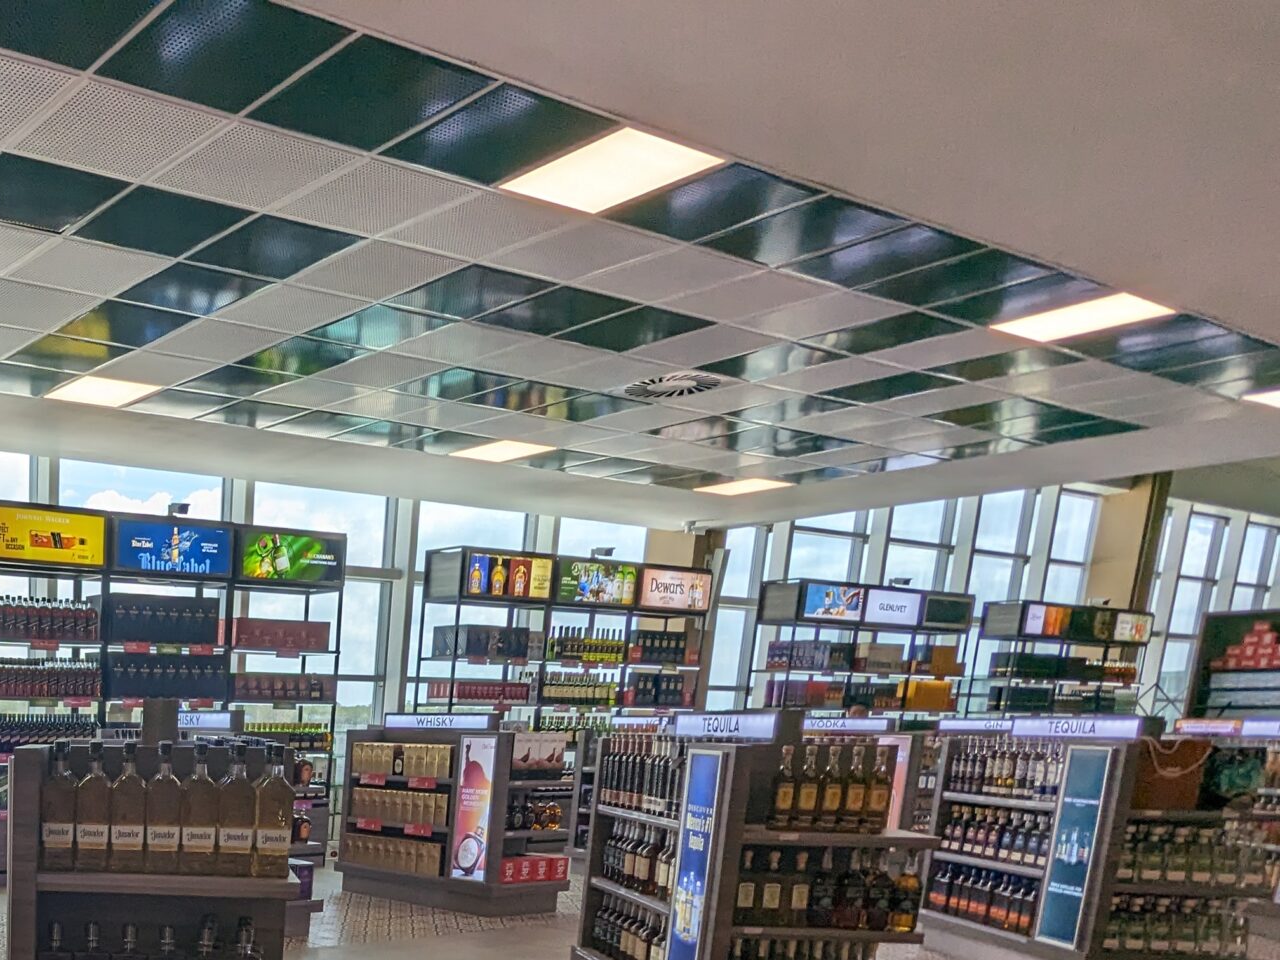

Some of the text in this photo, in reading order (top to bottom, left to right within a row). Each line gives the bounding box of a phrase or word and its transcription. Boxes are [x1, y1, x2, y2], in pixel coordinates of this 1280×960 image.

[138, 552, 172, 570] Blue
[650, 577, 685, 595] Dewar's
[878, 602, 908, 613] GLENLIVET
[178, 714, 200, 726] HISKY
[416, 717, 455, 726] WHISKY
[702, 717, 740, 733] TEQUILA
[810, 720, 846, 729] VODKA
[984, 722, 1004, 730] GIN
[1048, 720, 1096, 734] TEQUILA
